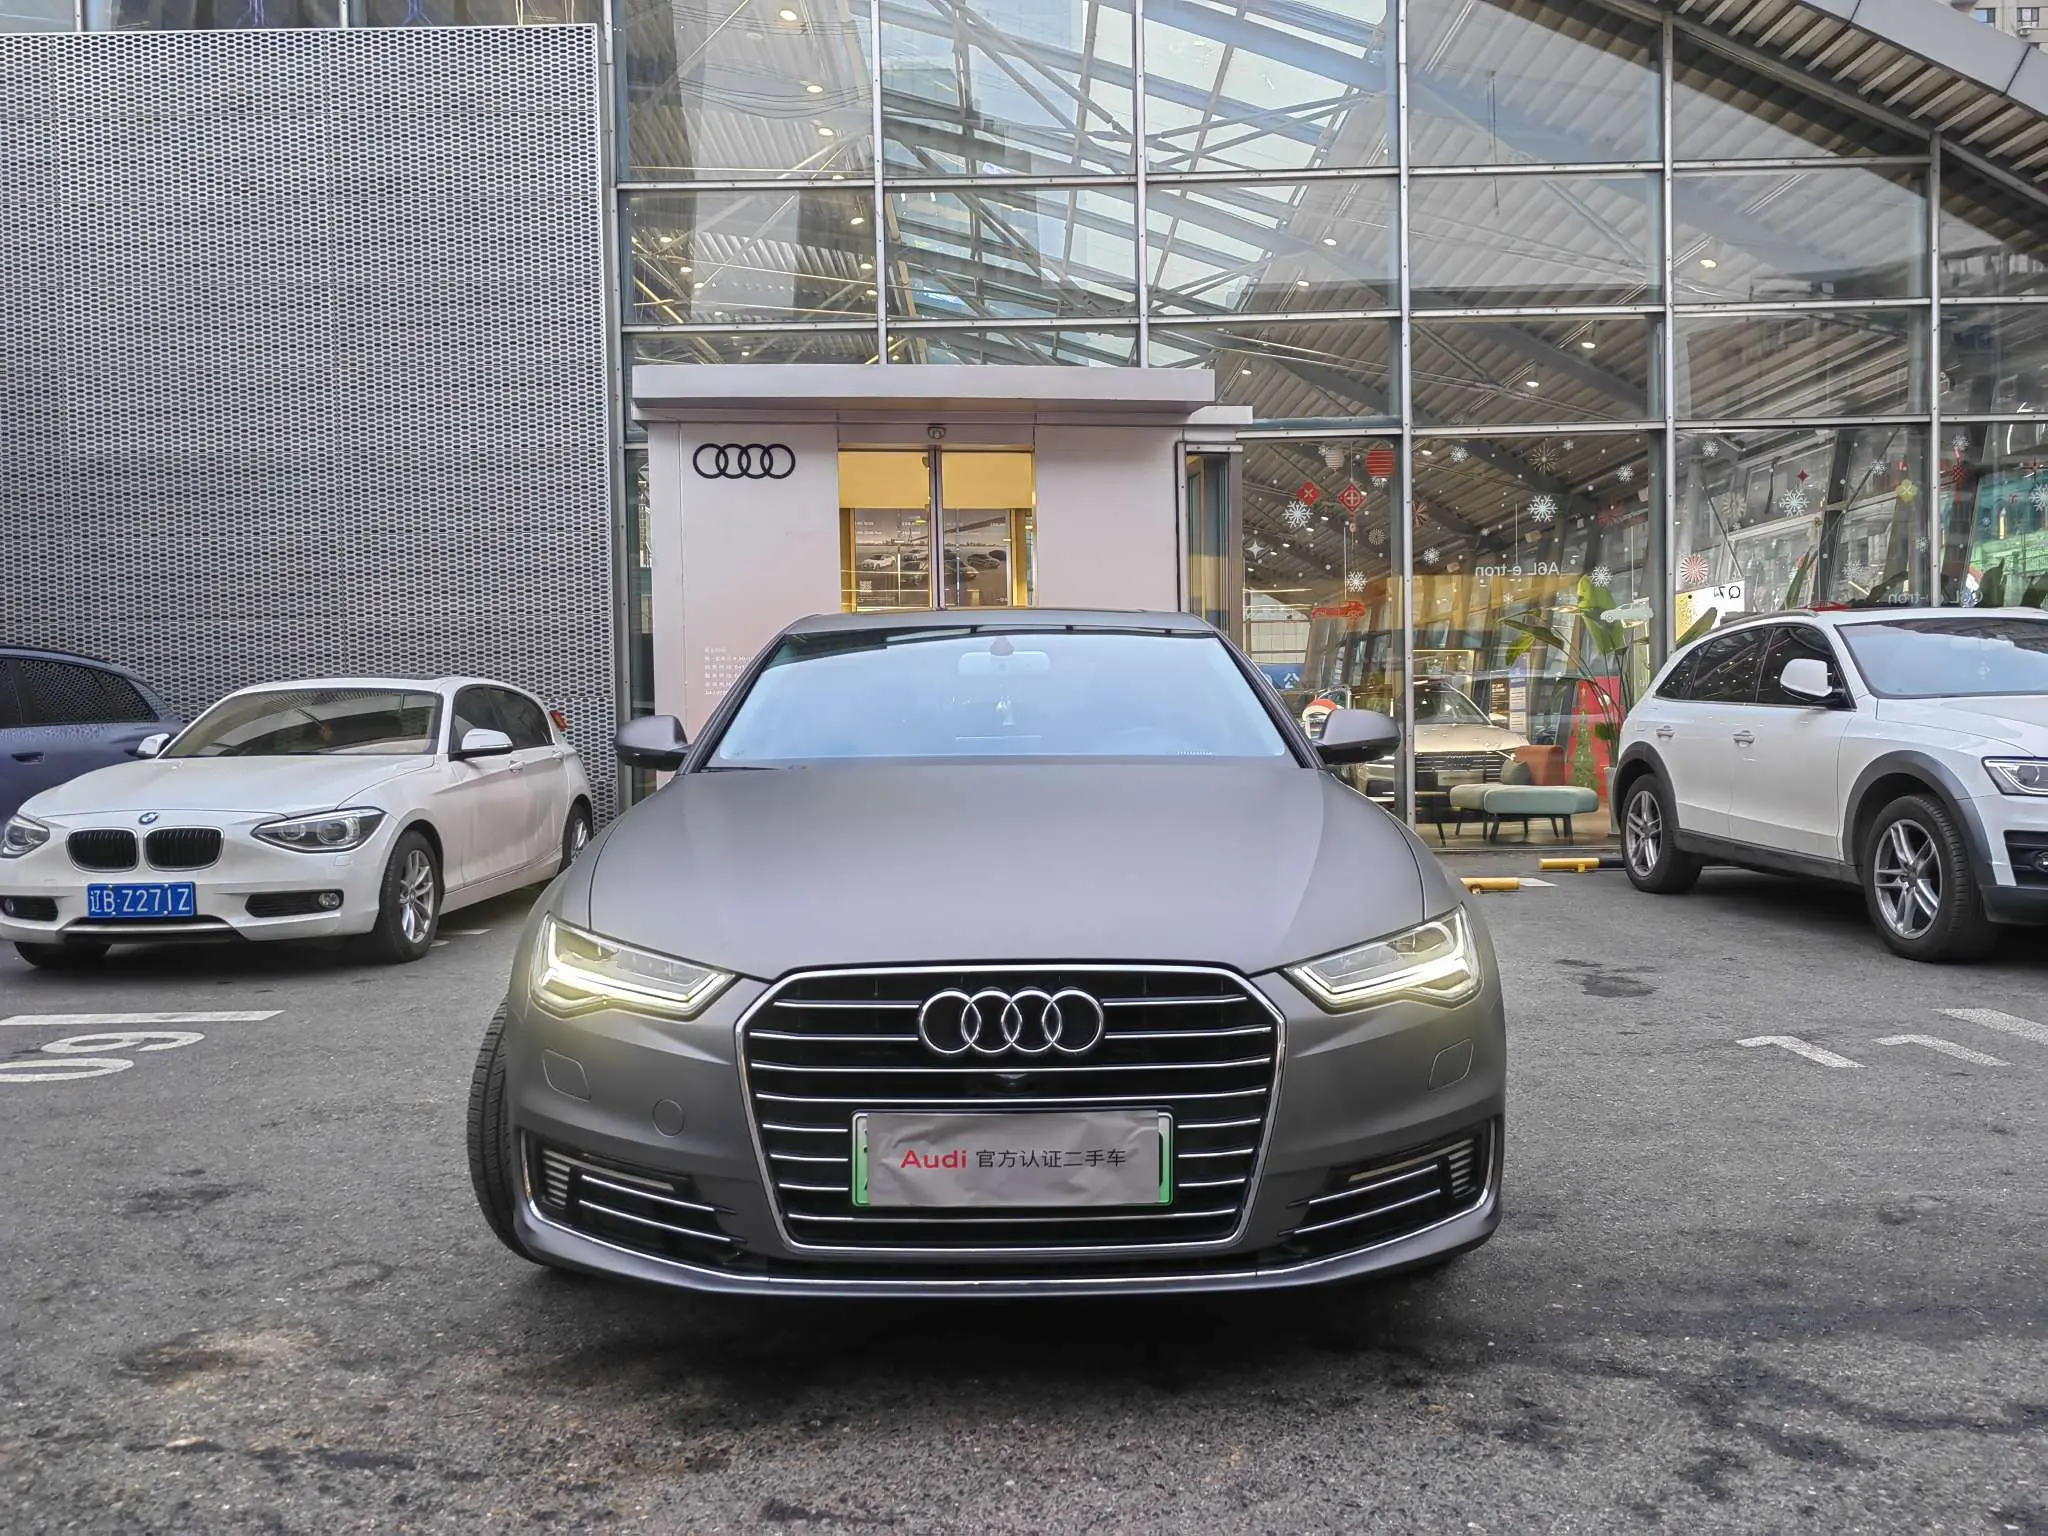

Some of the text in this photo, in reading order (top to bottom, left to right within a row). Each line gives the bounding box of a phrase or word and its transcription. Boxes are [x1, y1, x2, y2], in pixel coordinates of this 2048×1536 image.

[900, 1149, 1127, 1169] Audi 官方认证二手车
